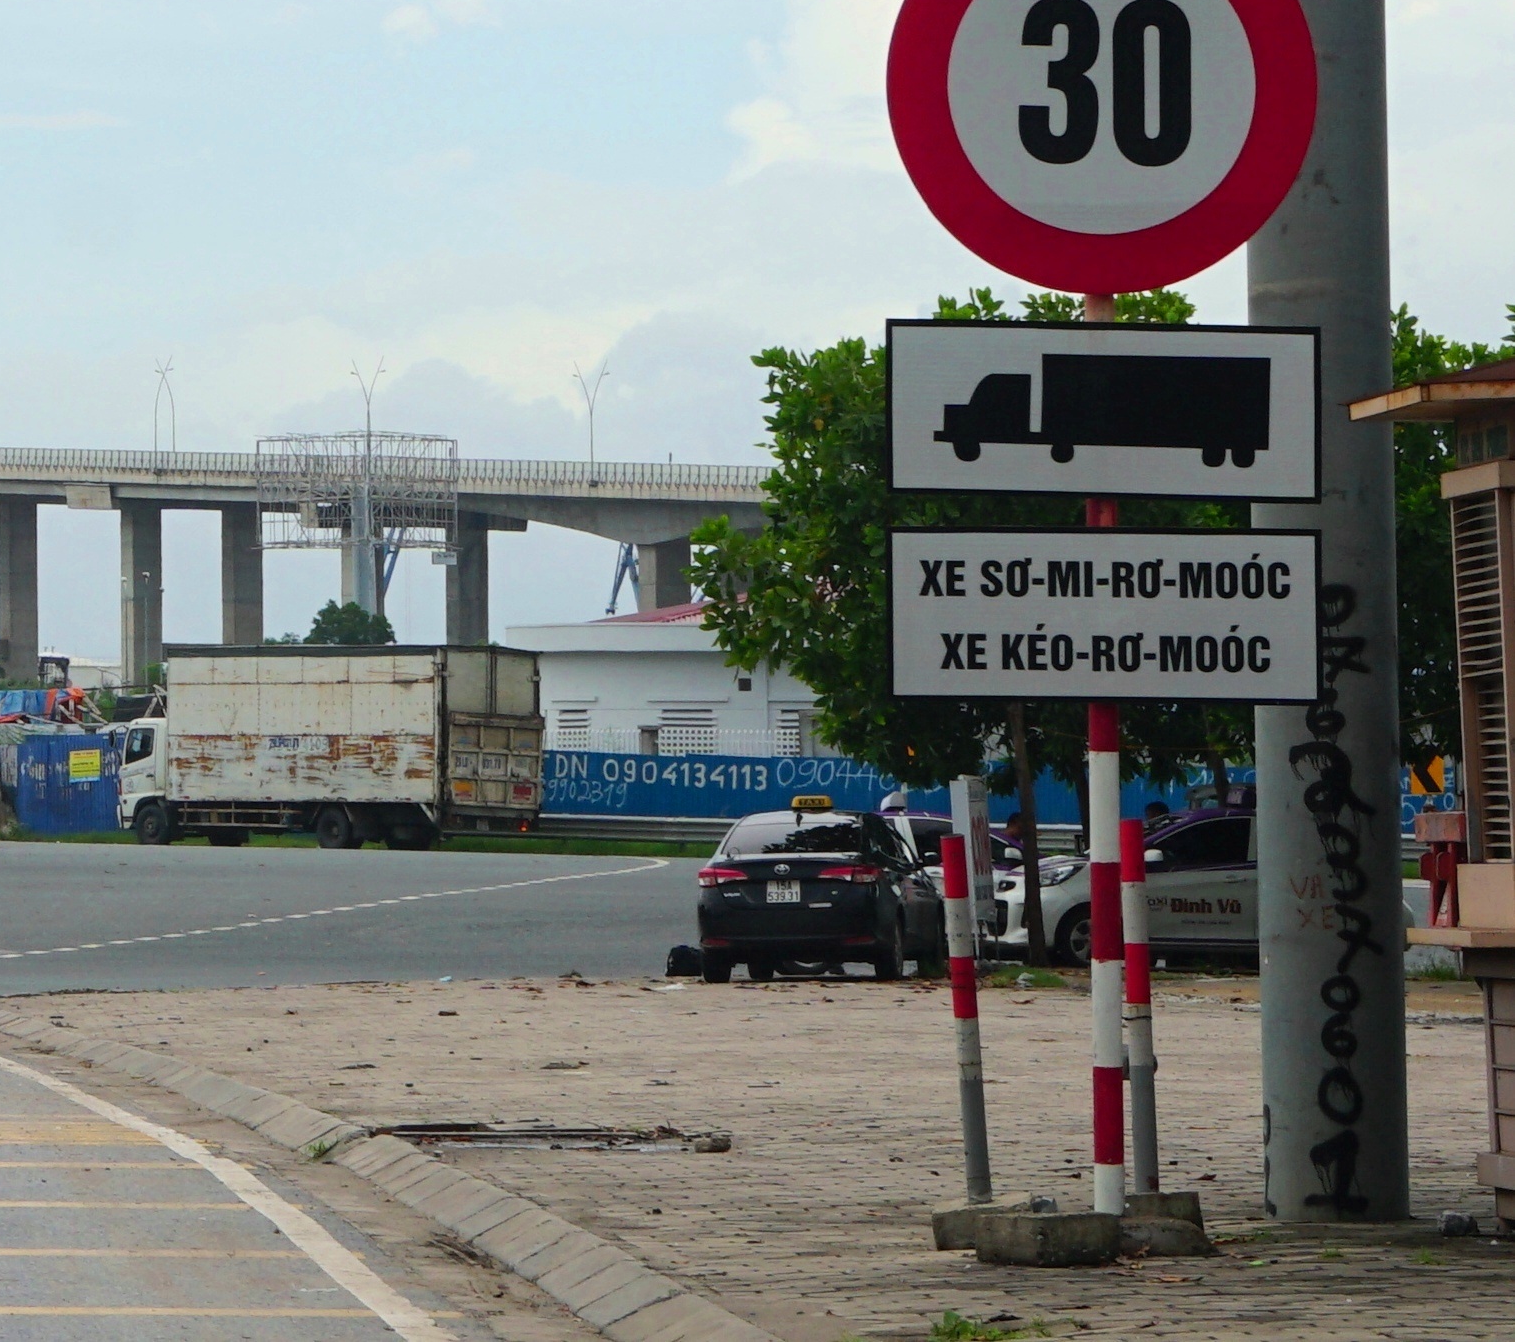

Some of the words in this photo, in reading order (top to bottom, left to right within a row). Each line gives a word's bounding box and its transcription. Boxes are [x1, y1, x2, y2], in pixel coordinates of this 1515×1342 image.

[919, 560, 966, 597] XE
[980, 553, 1290, 599] SƠ-MI-RƠ-MOÓC
[941, 633, 987, 670] XE
[1002, 623, 1270, 673] KÉO-RƠ-MOÓC
[602, 758, 769, 791] 0904134113
[776, 881, 793, 891] 15A
